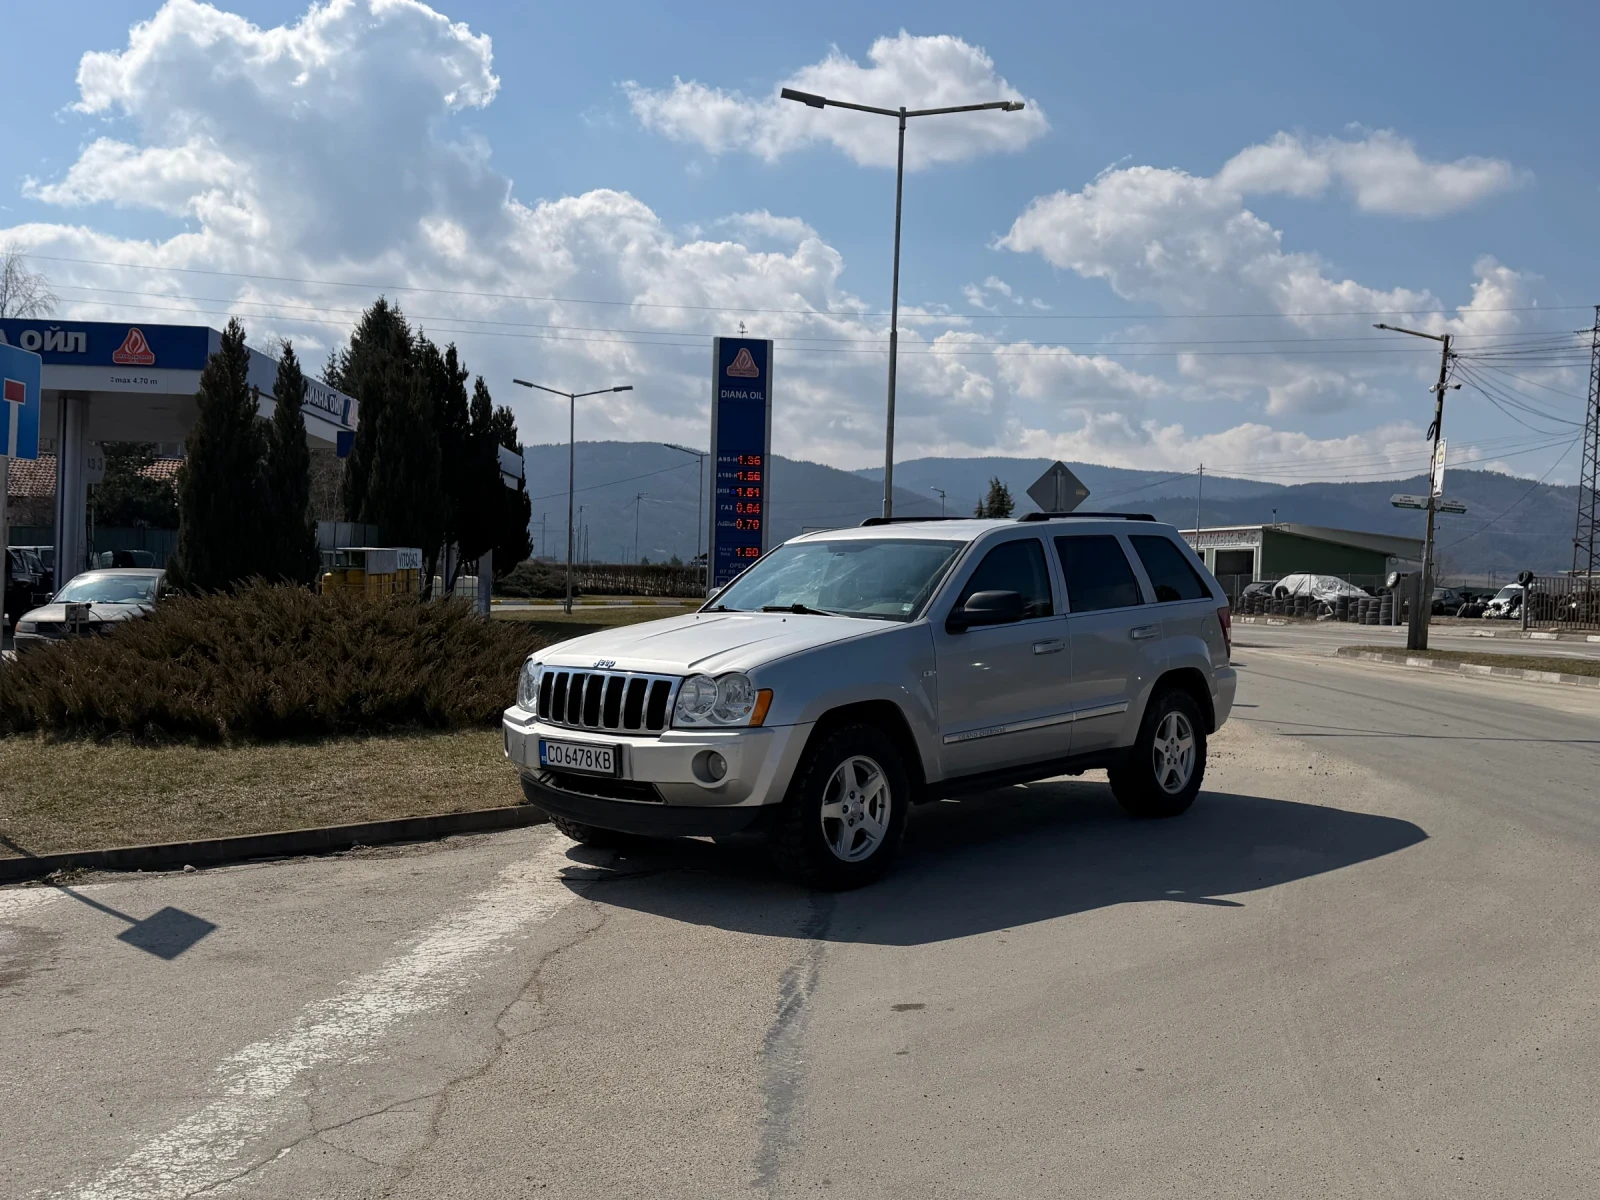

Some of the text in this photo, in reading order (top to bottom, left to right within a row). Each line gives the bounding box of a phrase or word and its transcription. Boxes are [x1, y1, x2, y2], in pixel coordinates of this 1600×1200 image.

[19, 325, 87, 352] ОЙЛ
[721, 389, 764, 400] DIANA OIL
[736, 518, 760, 530] 0.70
[593, 659, 616, 669] Jeep
[958, 732, 978, 740] GRAND
